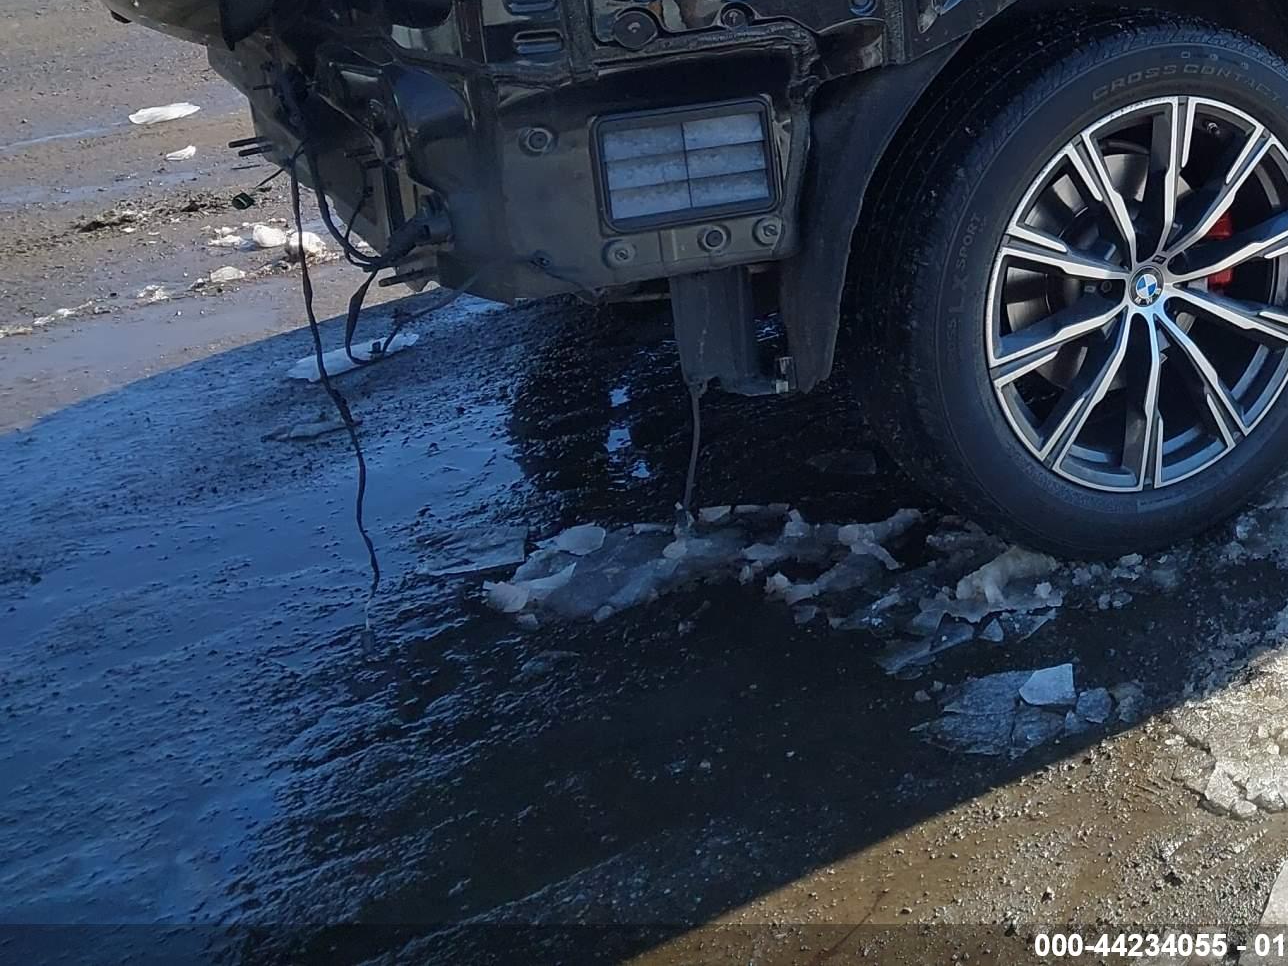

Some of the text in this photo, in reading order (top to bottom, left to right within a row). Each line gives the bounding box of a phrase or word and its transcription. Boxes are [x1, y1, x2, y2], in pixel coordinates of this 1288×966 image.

[1092, 63, 1281, 102] CROSS CONTACT
[956, 212, 981, 270] SPORT
